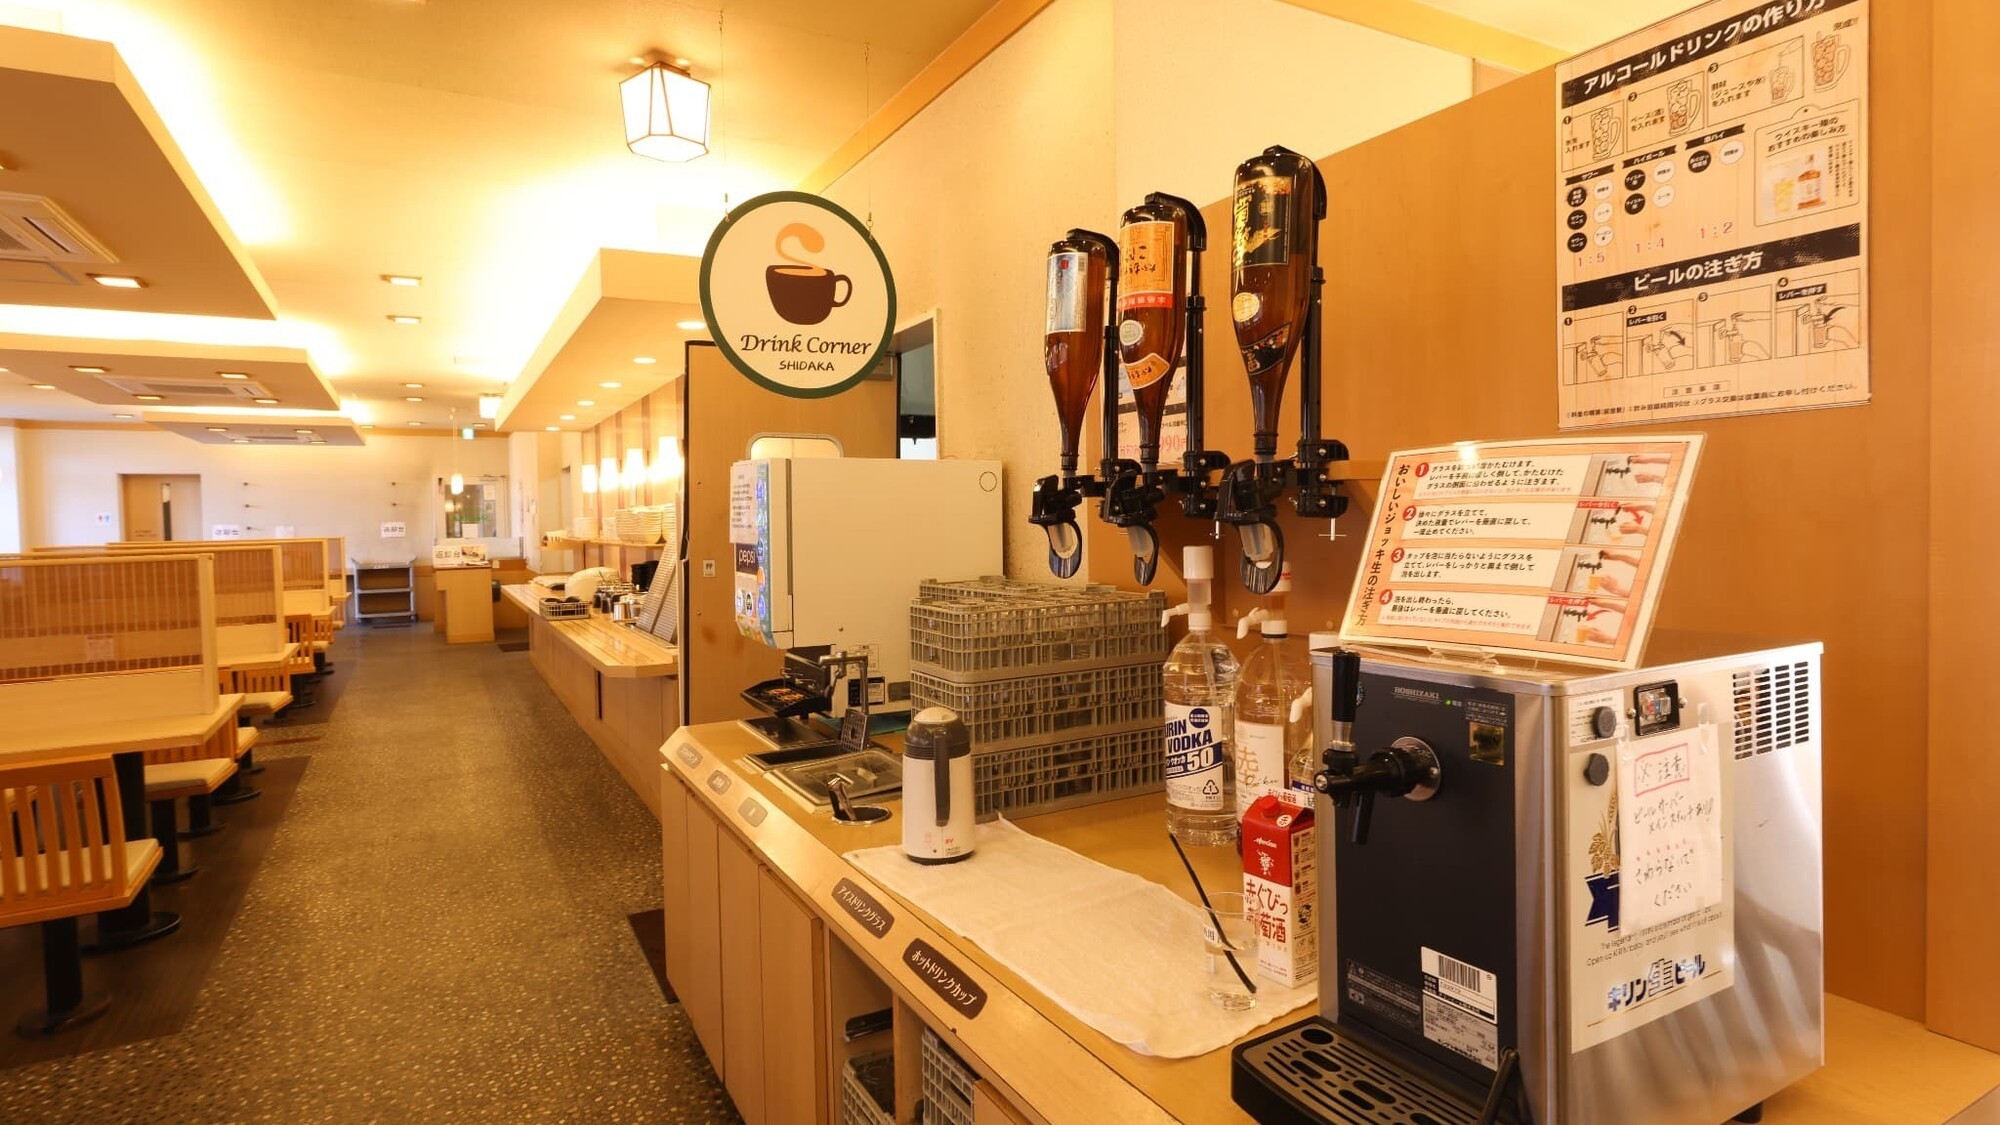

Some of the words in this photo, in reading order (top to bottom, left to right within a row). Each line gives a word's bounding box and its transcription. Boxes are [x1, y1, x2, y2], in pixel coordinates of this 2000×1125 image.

[1634, 251, 1764, 291] ビールの注ぎ方
[741, 334, 803, 352] Drink
[807, 336, 872, 355] Corner
[779, 360, 835, 371] SHIDAKA
[1355, 464, 1411, 627] おいしいジョッキ生の注ぎ方
[739, 549, 756, 568] pepsi
[1394, 686, 1440, 700] HOSHIZAKI
[1168, 729, 1213, 753] VODKA
[1187, 747, 1214, 772] 50
[836, 885, 887, 932] アイスドリンクグラス
[911, 950, 978, 1006] ホットドリンクカップ
[1608, 954, 1706, 1012] キリン生ビール
